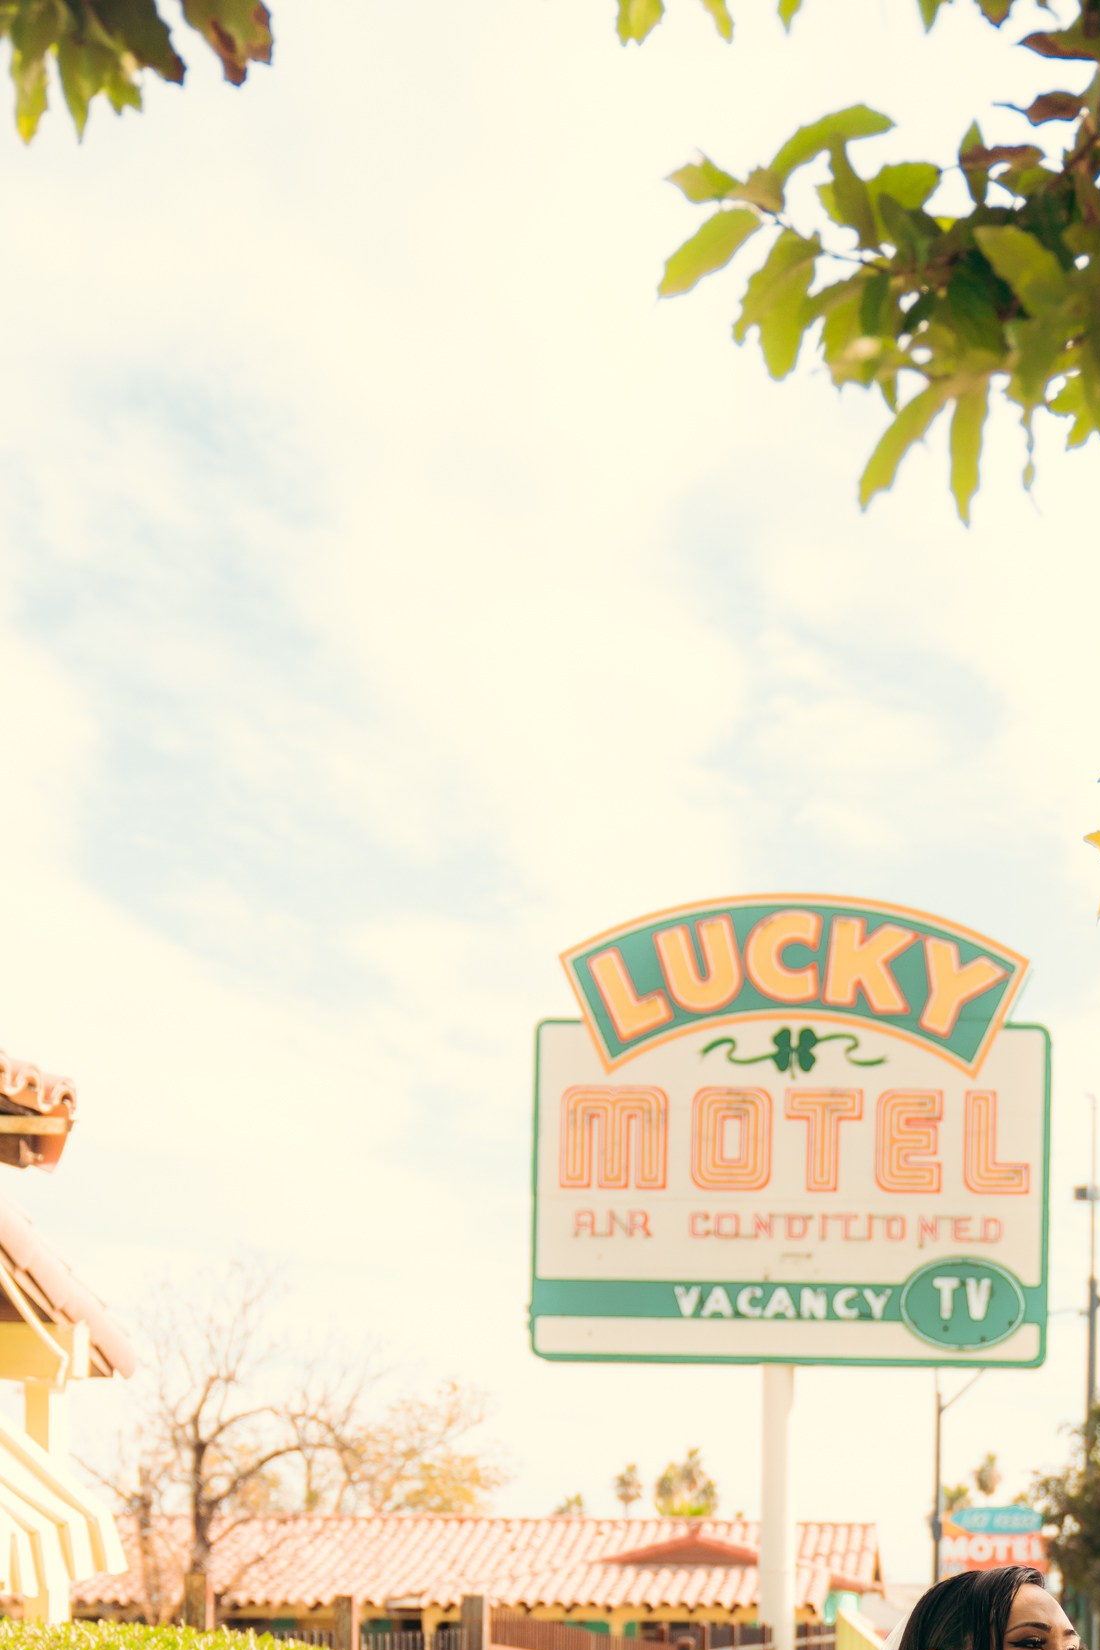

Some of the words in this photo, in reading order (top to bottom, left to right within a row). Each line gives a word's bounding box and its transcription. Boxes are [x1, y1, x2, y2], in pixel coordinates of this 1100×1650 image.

[587, 909, 1010, 1043] LUCKY
[559, 1085, 1031, 1194] MOTEL
[574, 1208, 653, 1239] AIR
[688, 1211, 1004, 1243] CONDITIONED
[673, 1285, 892, 1321] VACANCY
[932, 1277, 993, 1322] TV
[941, 1534, 1043, 1563] MOTEL
